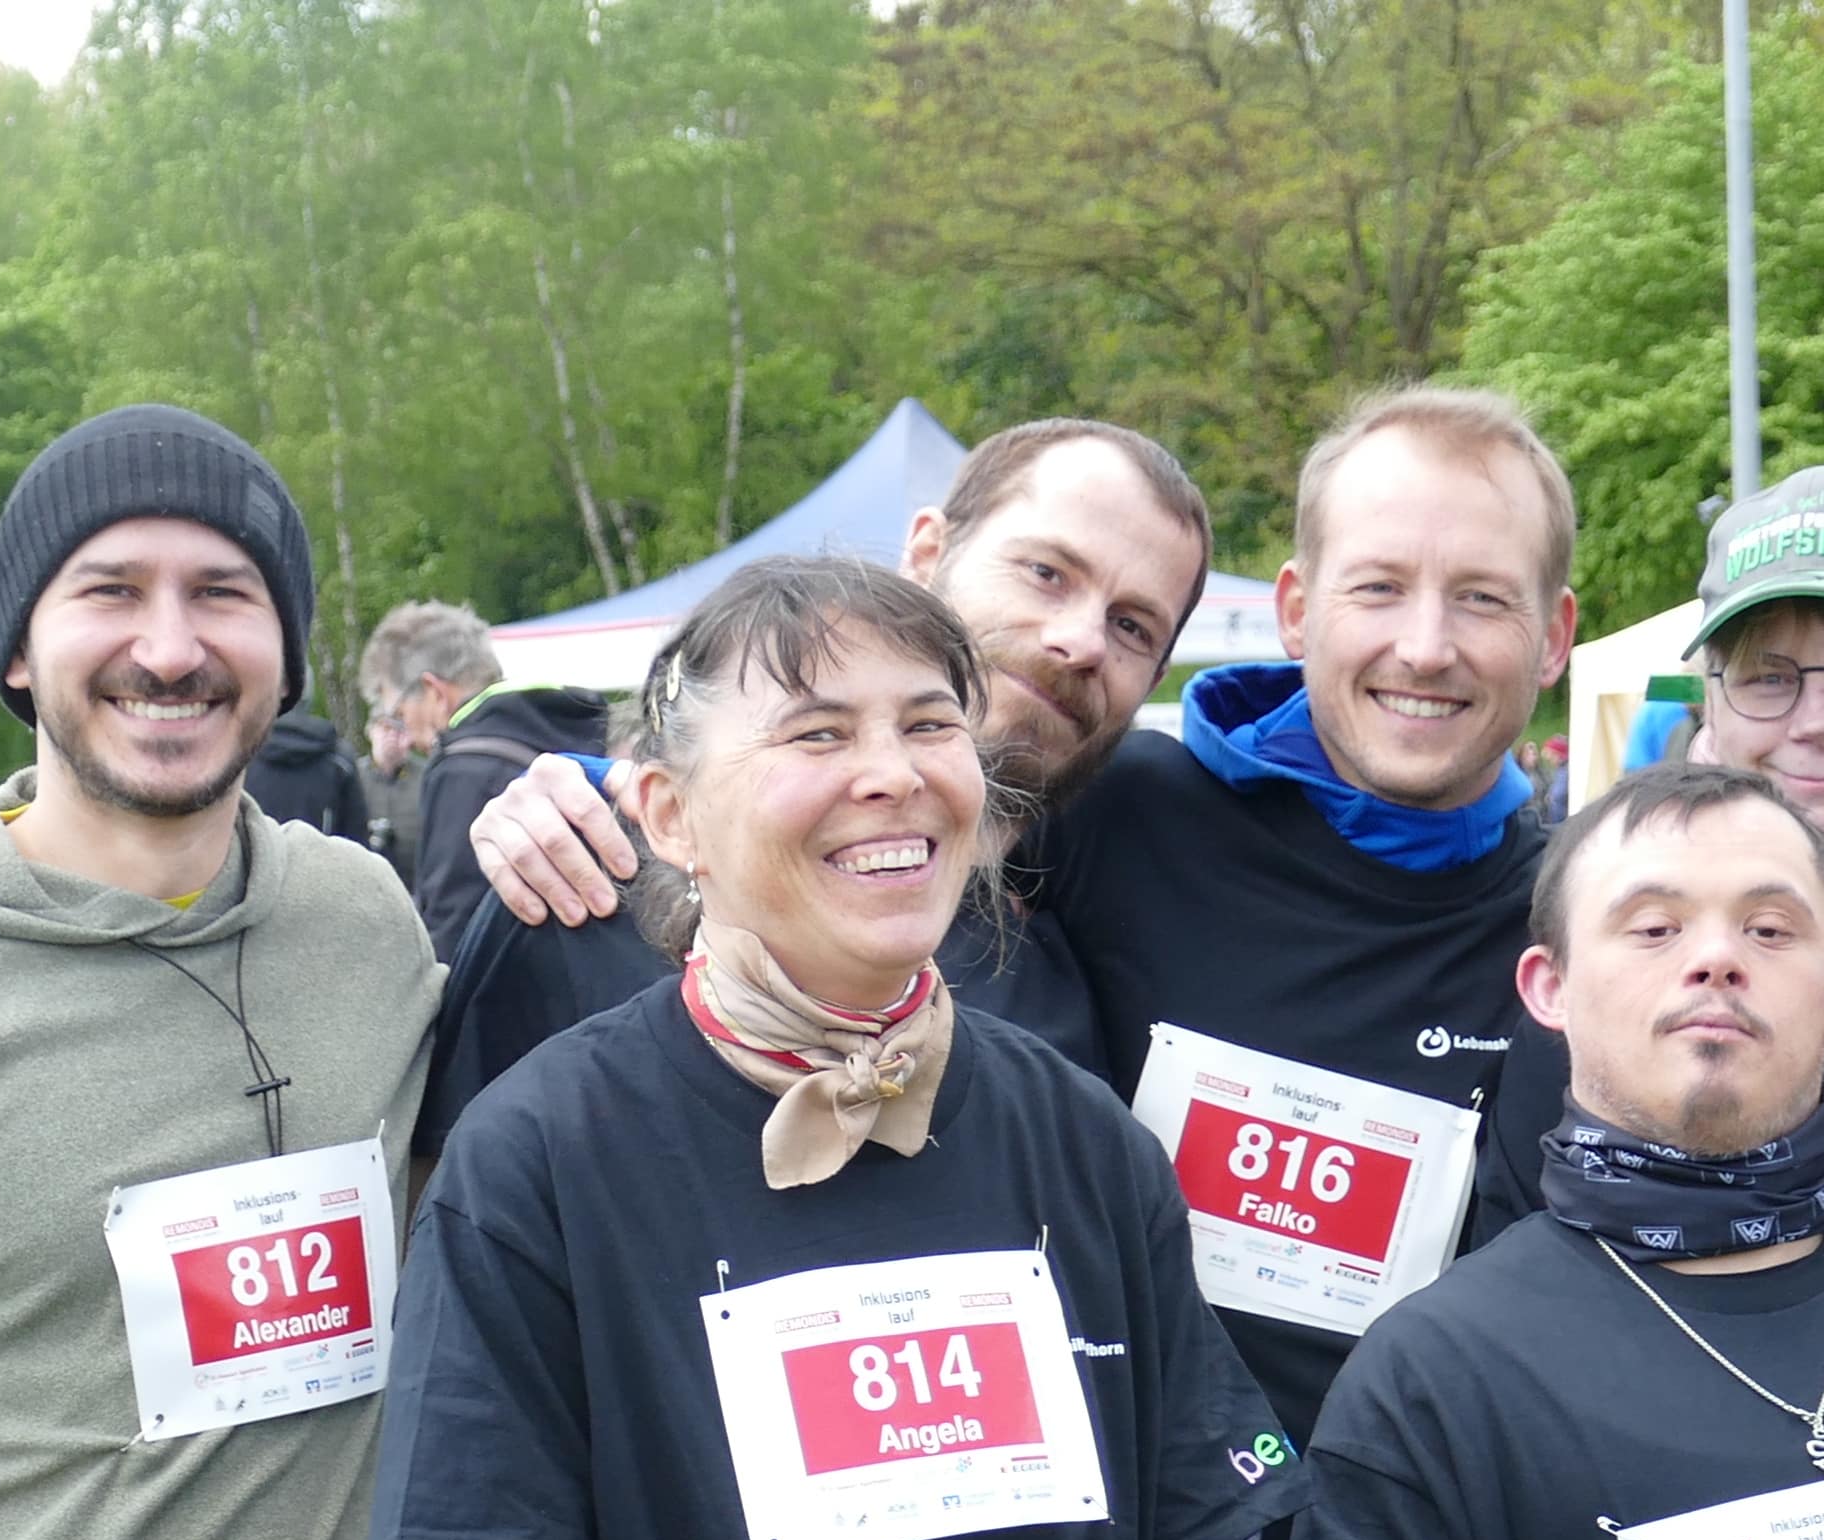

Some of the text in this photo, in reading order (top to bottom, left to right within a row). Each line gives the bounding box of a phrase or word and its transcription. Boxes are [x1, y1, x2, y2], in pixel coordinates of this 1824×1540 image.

[1292, 1106, 1319, 1125] lauf
[1228, 1122, 1356, 1204] 816
[260, 1209, 284, 1225] lauf
[1238, 1192, 1317, 1235] Falko
[227, 1231, 338, 1307] 812
[233, 1305, 351, 1349] Alexander
[888, 1310, 916, 1325] lauf
[848, 1334, 982, 1412] 814
[878, 1415, 984, 1455] Angela
